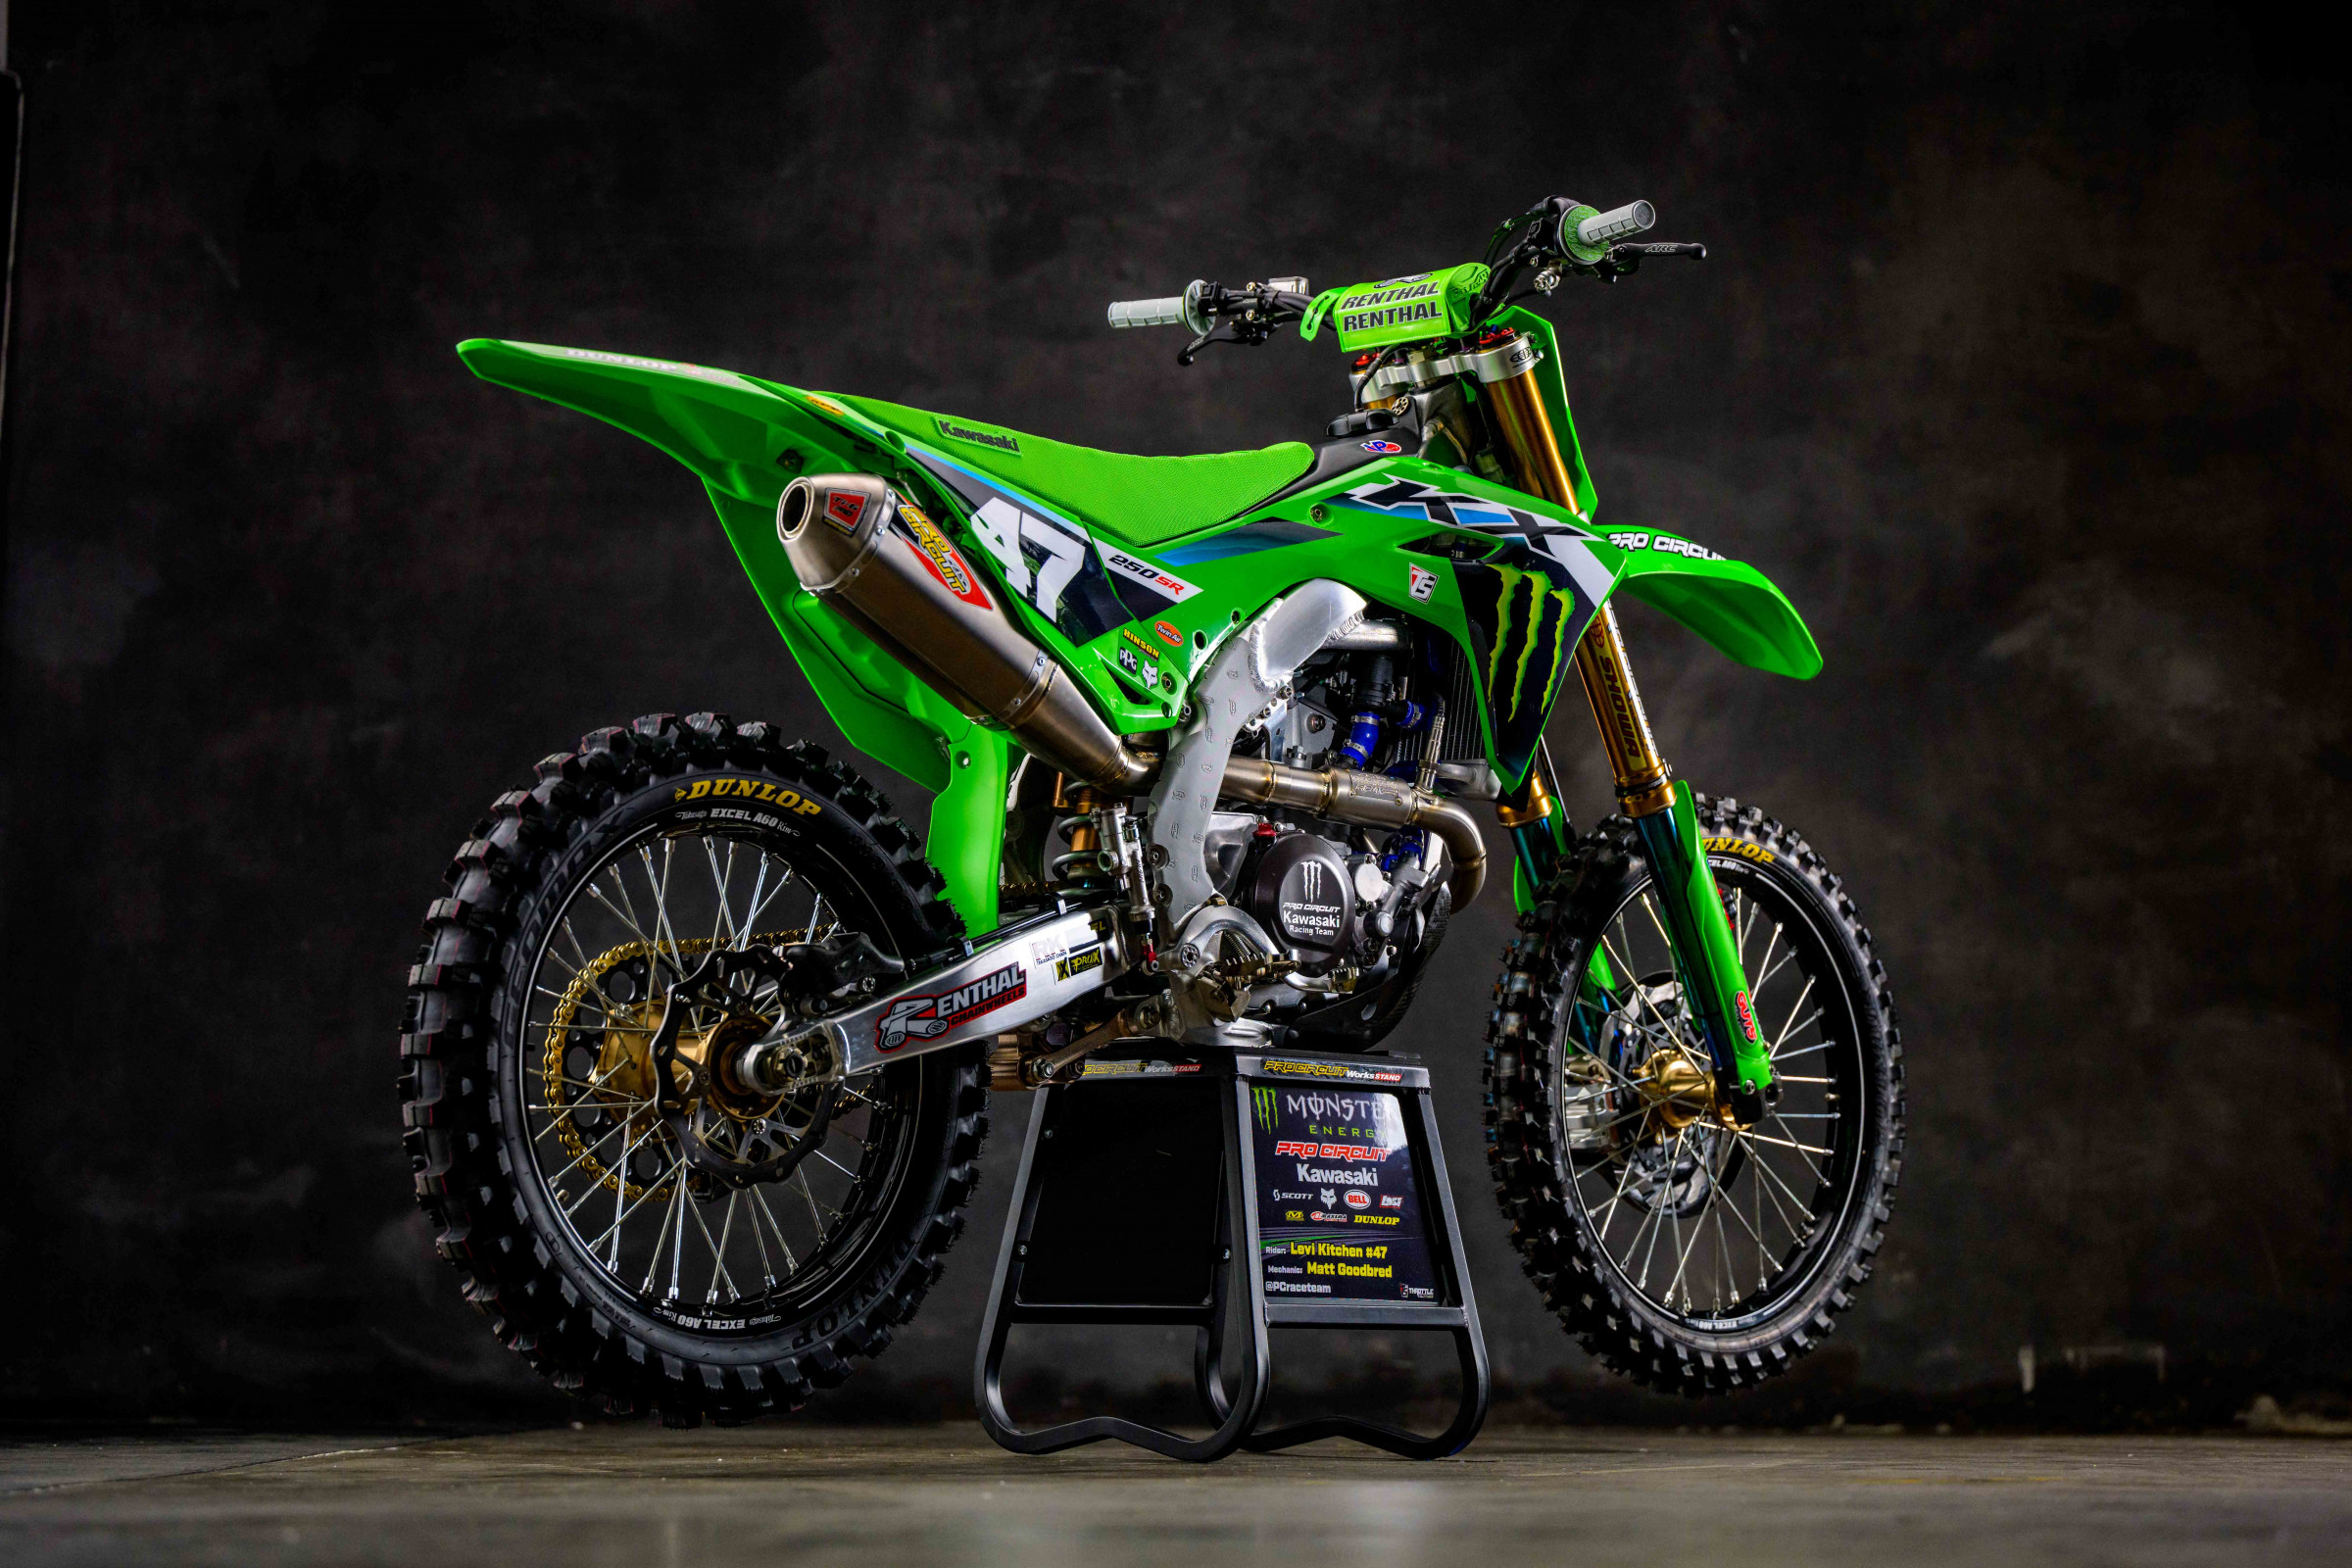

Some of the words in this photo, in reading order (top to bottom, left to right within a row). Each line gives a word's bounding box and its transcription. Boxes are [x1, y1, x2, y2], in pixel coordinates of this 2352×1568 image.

[1341, 282, 1440, 310] RENTHAL
[1344, 301, 1443, 332] RENTHAL
[939, 420, 1020, 453] Kawasaki
[907, 506, 951, 554] PRO
[899, 506, 966, 594] CIRCUIT
[1608, 532, 1649, 551] PRO
[970, 497, 1086, 622] 47
[1123, 627, 1159, 659] HINSON
[1157, 623, 1172, 637] Twin
[1171, 633, 1182, 643] Air
[1599, 655, 1642, 758] SHOWA
[686, 778, 822, 815] DUNLOP
[710, 808, 752, 821] EXCEL
[753, 812, 779, 827] A60
[1702, 837, 1776, 862] UNLOP
[1283, 910, 1340, 927] Kawasaki
[1303, 904, 1341, 912] CIRCUIT
[1290, 924, 1313, 936] Racing
[1315, 927, 1334, 936] Team
[951, 986, 1025, 1026] CHAINWHEELS
[1737, 991, 1757, 1040] GUTS
[1093, 1062, 1148, 1075] CIRCUIT
[1145, 1064, 1173, 1073] Works
[1173, 1064, 1200, 1073] STAND
[1264, 1060, 1295, 1073] PRO
[1295, 1062, 1348, 1077] CIRCUIT
[1347, 1070, 1375, 1079] Works
[1374, 1072, 1401, 1081] STAND
[1275, 1141, 1318, 1159] PRO
[1320, 1145, 1392, 1162] CIRCUIT
[1297, 1163, 1379, 1186] Kawasaki
[1348, 1195, 1367, 1203] BELL
[1354, 1214, 1399, 1225] DUNLOP
[1291, 1242, 1314, 1254] Levi
[1318, 1243, 1363, 1257] Kitchen
[1366, 1247, 1388, 1258] #47
[1268, 1265, 1302, 1274] Mechanic:
[1307, 1261, 1335, 1275] Matt
[1338, 1263, 1393, 1278] Goodbred
[1265, 1281, 1331, 1294] @PCraceteam
[677, 1314, 702, 1329] A60
[704, 1318, 746, 1330] EXCEL
